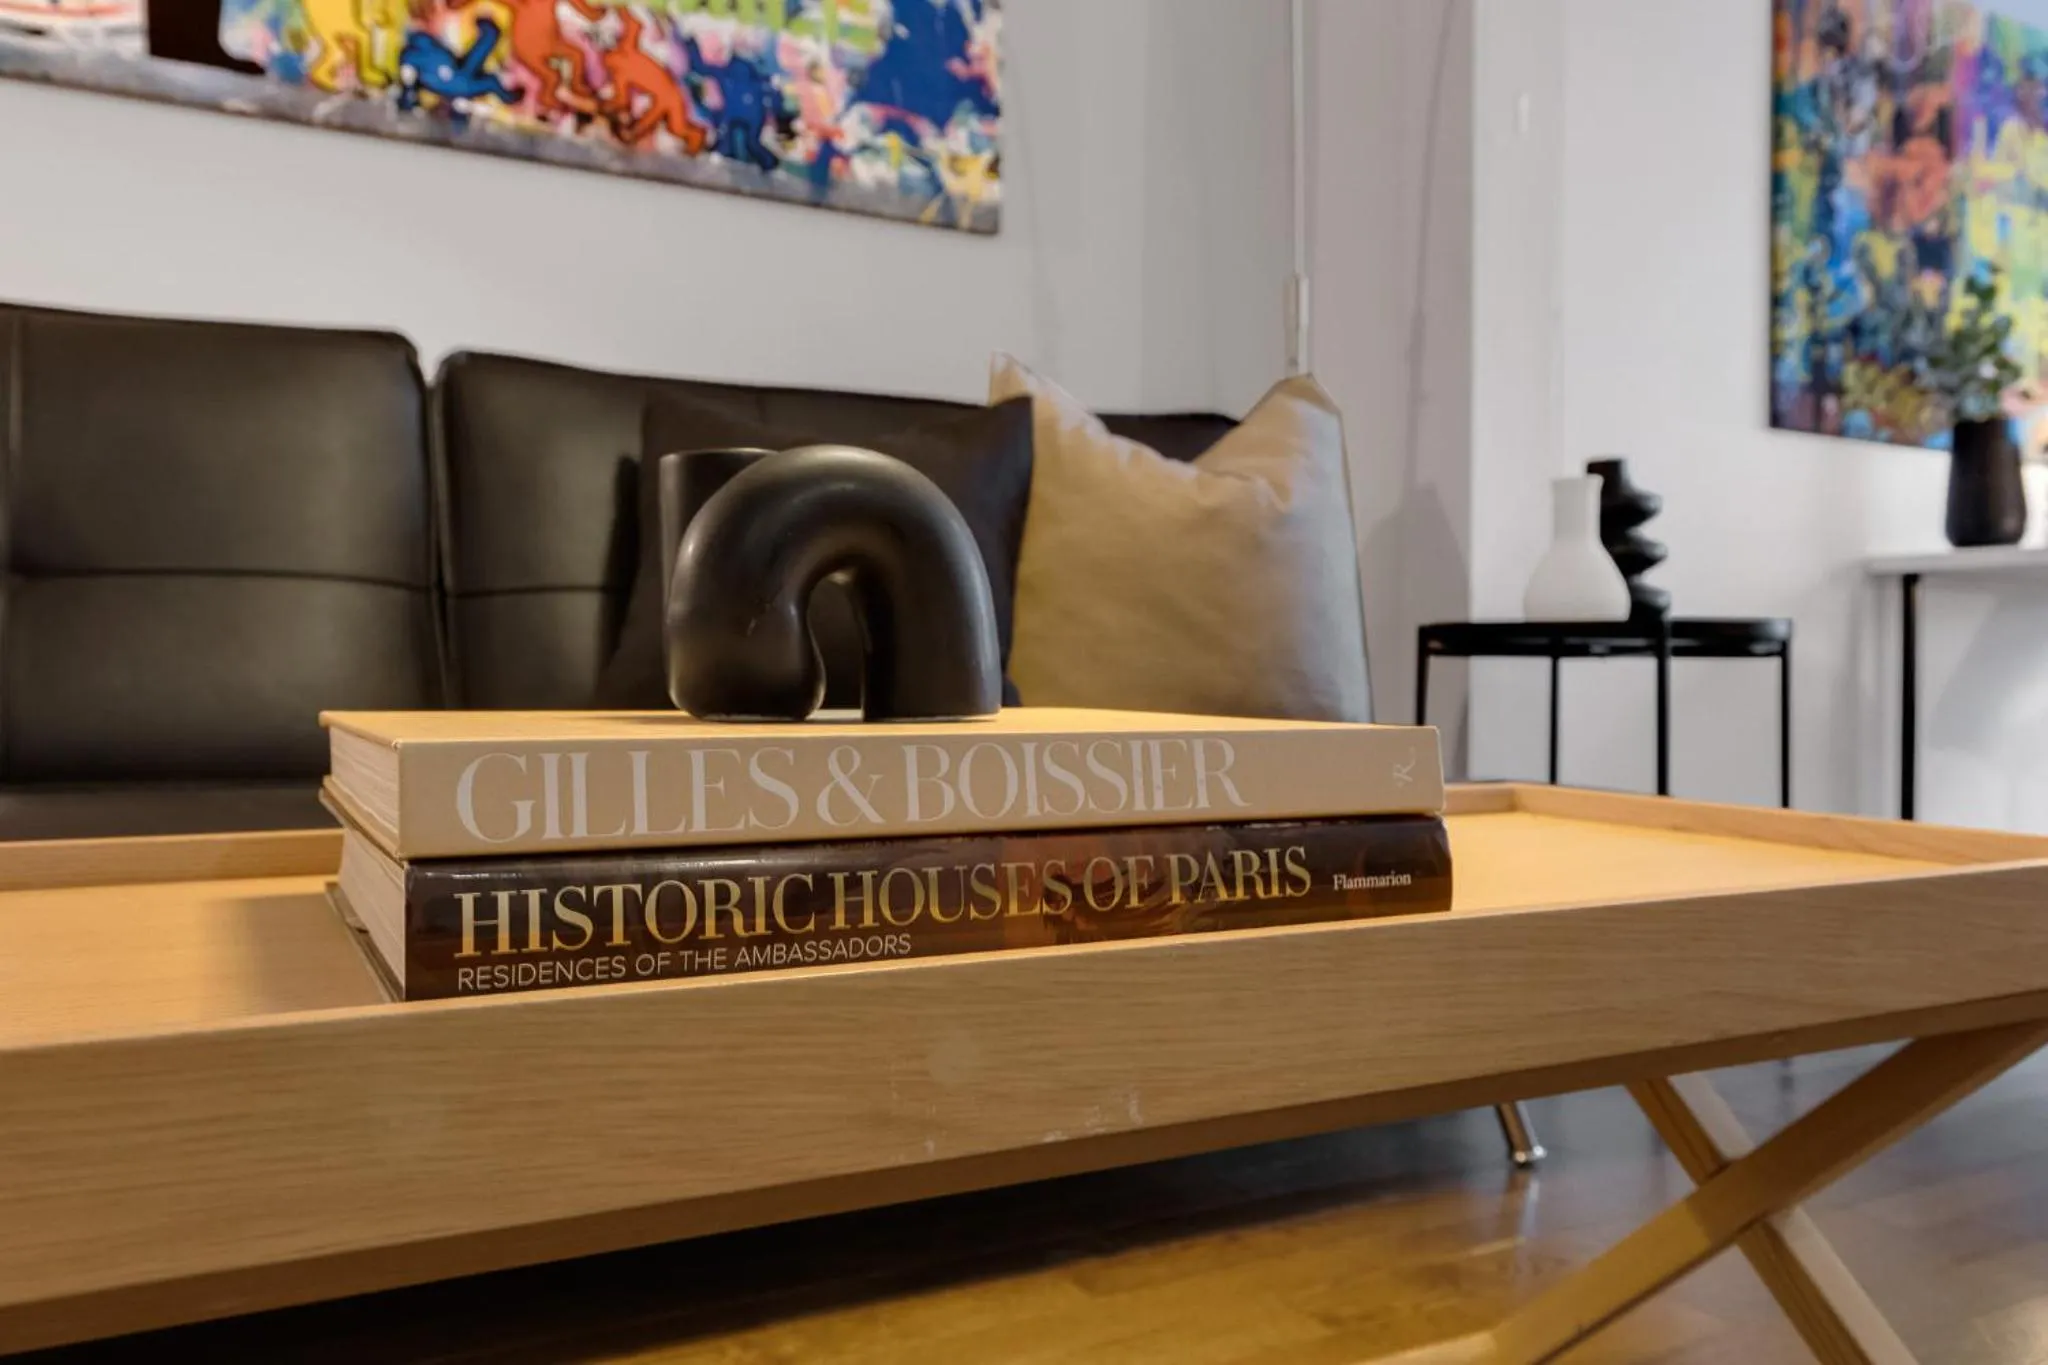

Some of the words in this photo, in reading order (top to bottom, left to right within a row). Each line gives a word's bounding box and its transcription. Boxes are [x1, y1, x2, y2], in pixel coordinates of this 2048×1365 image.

[456, 746, 799, 844] GILLES
[816, 745, 887, 827] &
[902, 738, 1252, 824] BOISSIER
[453, 873, 816, 959] HISTORIC
[827, 859, 1072, 930] HOUSES
[1083, 854, 1155, 910] OF
[1166, 846, 1312, 905] PARIS
[1332, 872, 1412, 891] Flammarion
[457, 954, 626, 992] RESIDENCES
[635, 952, 672, 975] OF
[679, 947, 727, 972] THE
[734, 932, 912, 967] AMBASSADORS
